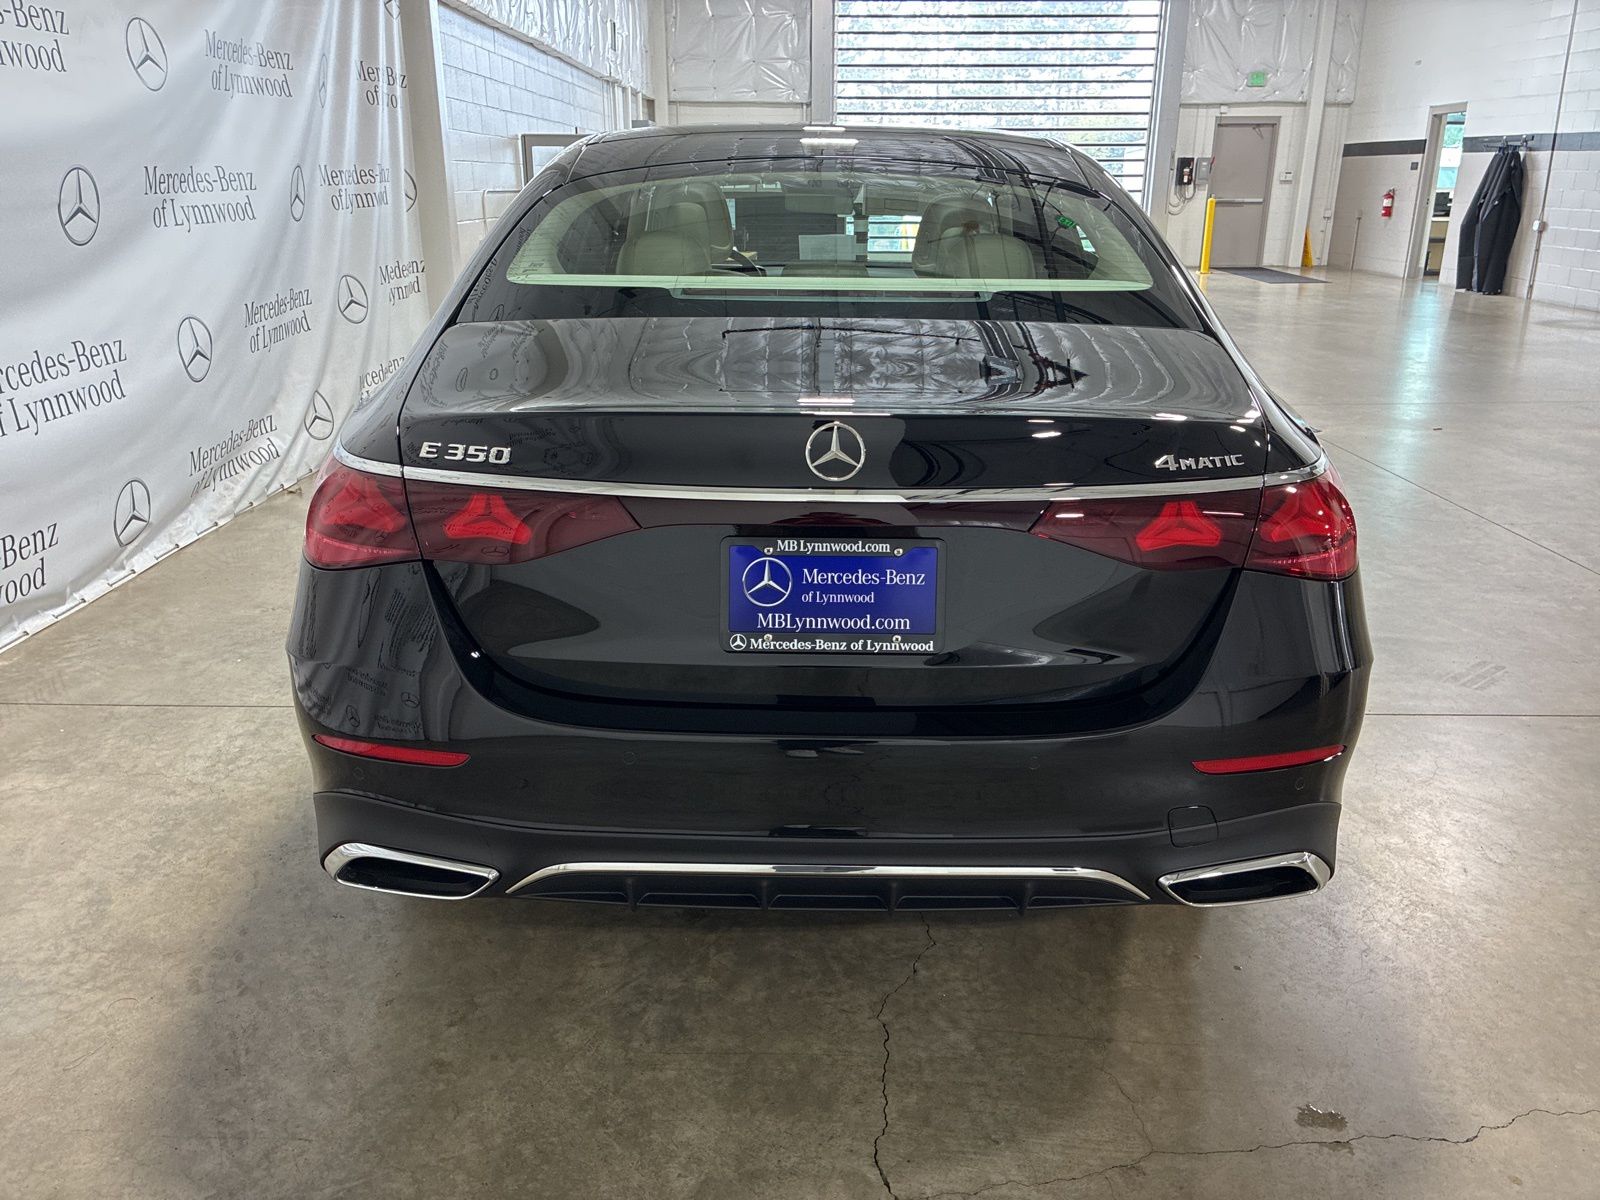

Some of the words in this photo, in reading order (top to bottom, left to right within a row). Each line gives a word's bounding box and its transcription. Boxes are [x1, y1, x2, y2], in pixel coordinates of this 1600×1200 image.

[205, 29, 294, 71] Mercedes-Benz
[211, 63, 223, 91] of
[224, 65, 293, 99] Lynnwood
[144, 165, 257, 195] Mercedes-Benz
[153, 198, 168, 228] of
[170, 194, 257, 233] Lynnwood
[331, 188, 344, 211] of
[244, 287, 312, 328] Mercedes-Benz
[250, 326, 261, 353] of
[262, 309, 312, 353] Lynnwood
[6, 368, 127, 436] Lynnwood
[189, 414, 278, 477] Mercedes-Benz
[419, 441, 442, 458] E
[443, 443, 511, 464] 350
[202, 437, 281, 492] Lynnwood
[799, 540, 891, 554] Lynnwood.com
[802, 568, 926, 586] Mercedes-Benz
[801, 591, 814, 603] of
[816, 591, 875, 606] Lynnwood
[757, 613, 911, 633] MBLynnwood.com
[750, 638, 847, 651] Mercedes-Benz
[850, 640, 864, 651] of
[866, 640, 934, 653] Lynnwood
